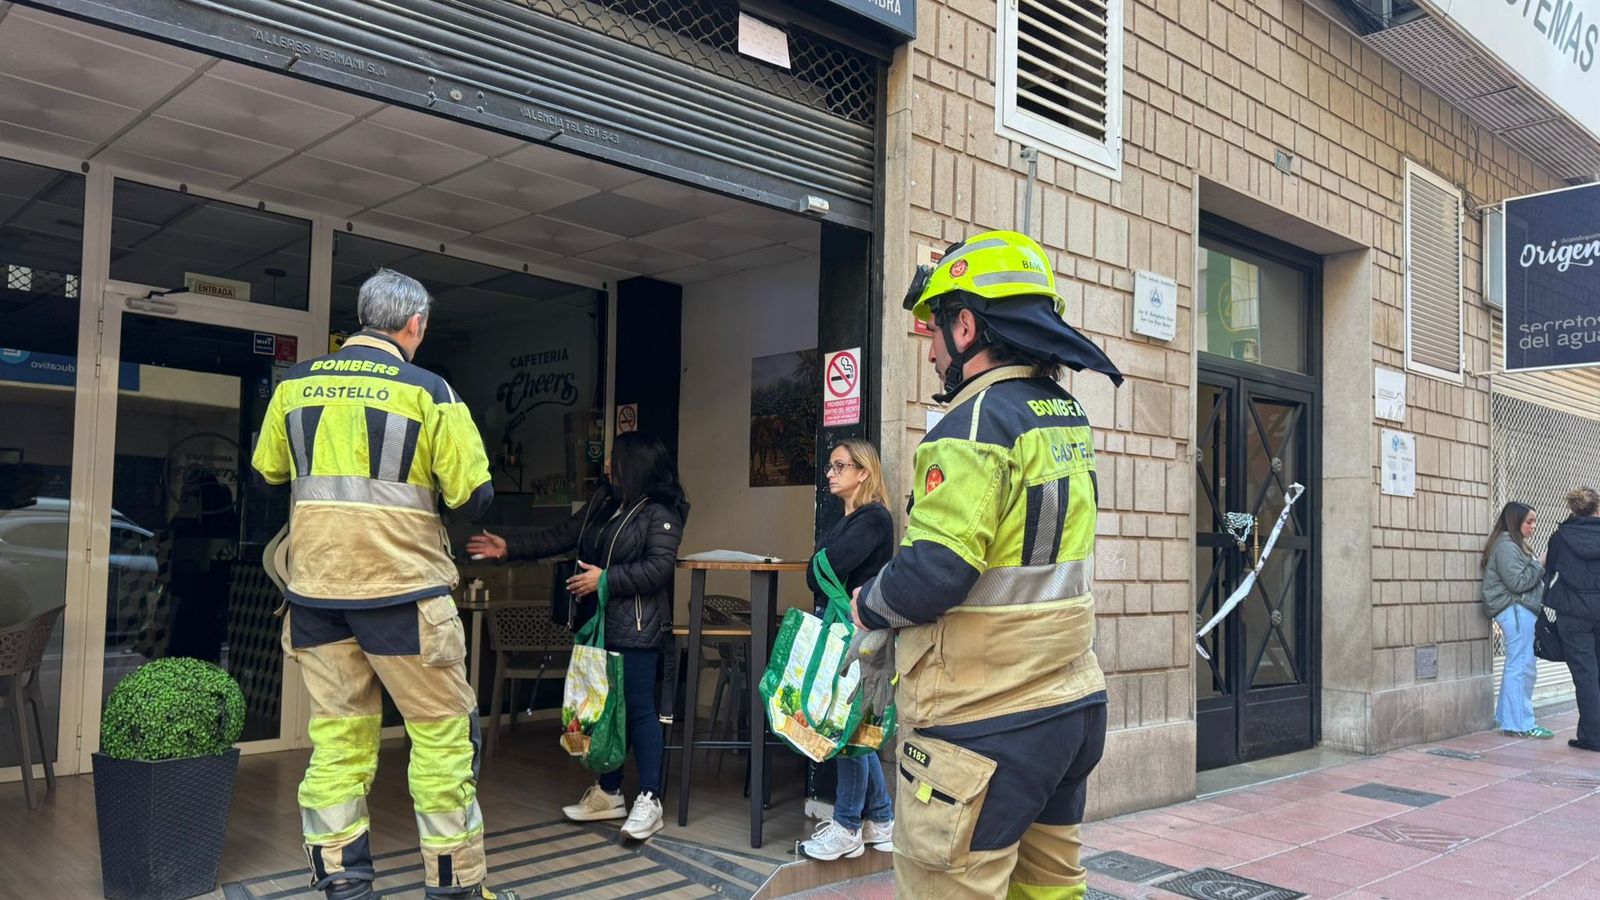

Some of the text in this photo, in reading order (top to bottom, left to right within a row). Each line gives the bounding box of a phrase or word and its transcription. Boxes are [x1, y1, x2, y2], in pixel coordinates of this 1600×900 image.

[246, 24, 311, 56] TALLERES
[1505, 0, 1598, 72] EMAS
[519, 105, 564, 128] VALENCIA
[198, 284, 233, 297] ENTRADA
[1519, 332, 1550, 350] del
[310, 359, 400, 376] BOMBERS
[510, 348, 569, 369] CAFETERIA
[303, 386, 389, 401] CASTELLÓ
[496, 371, 578, 414] Cheers
[908, 746, 926, 764] 1182
